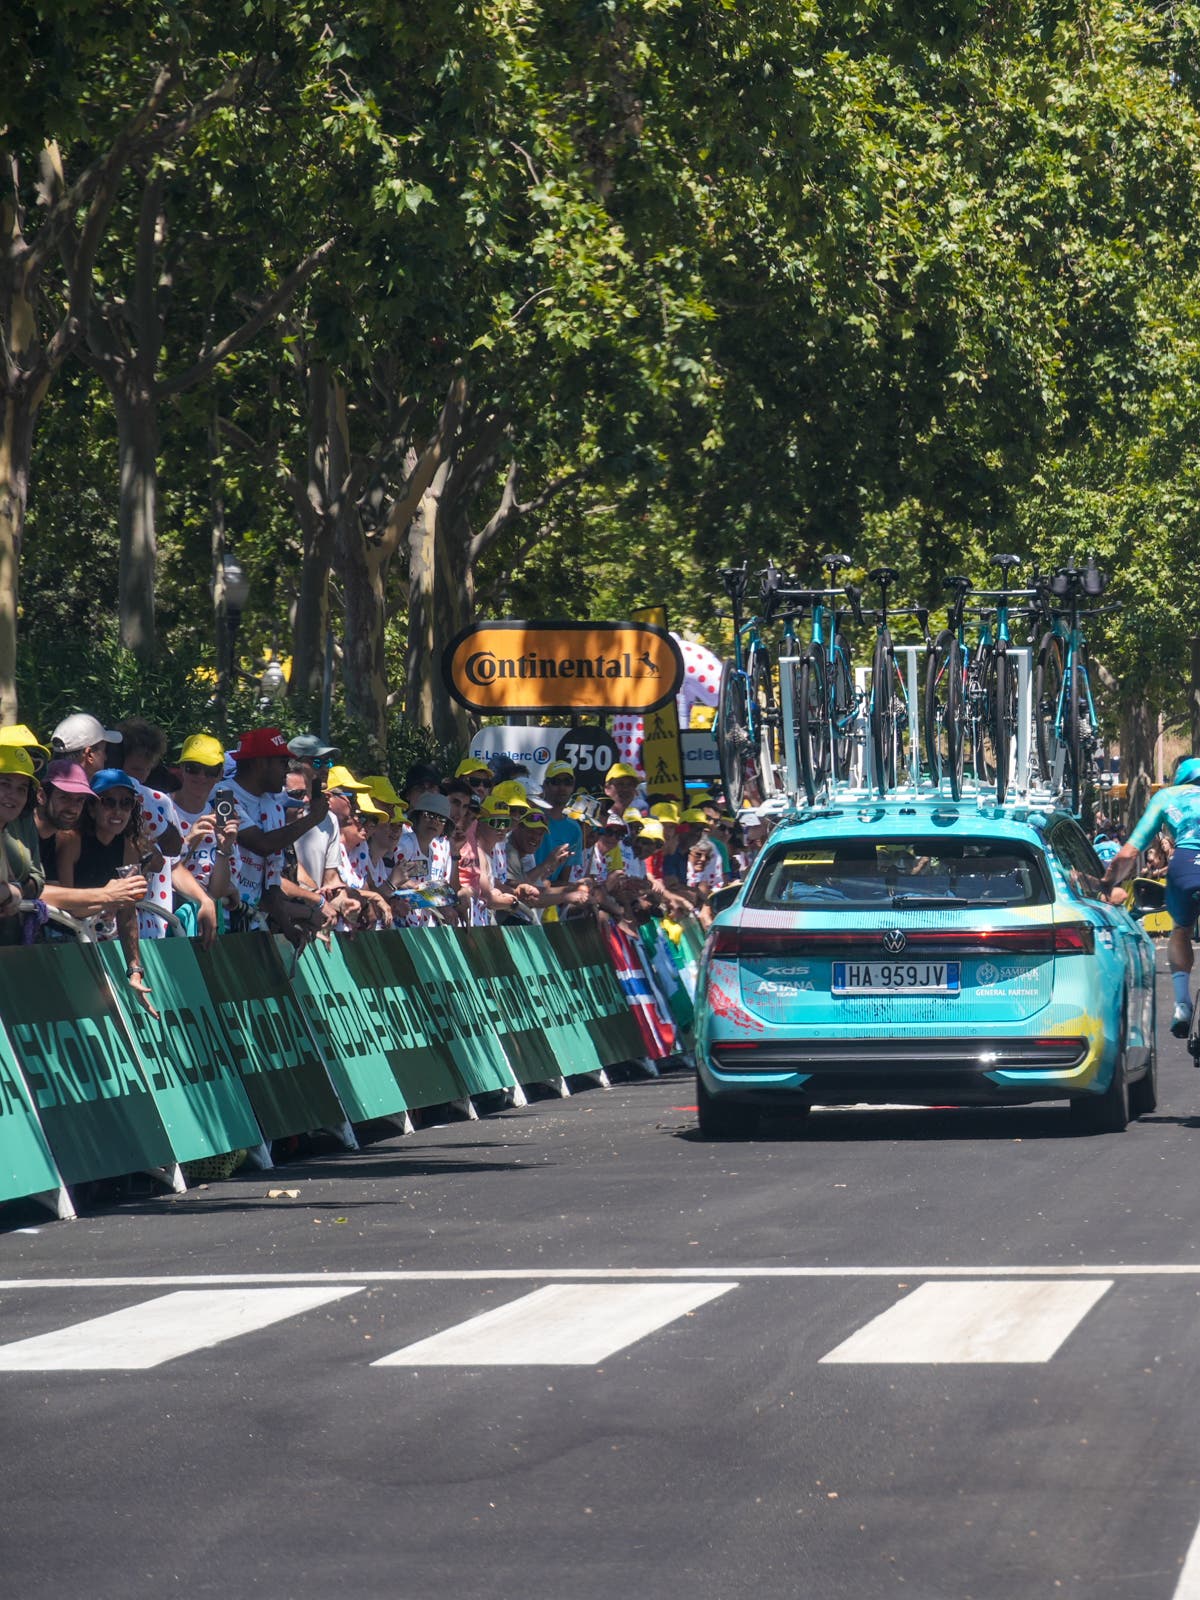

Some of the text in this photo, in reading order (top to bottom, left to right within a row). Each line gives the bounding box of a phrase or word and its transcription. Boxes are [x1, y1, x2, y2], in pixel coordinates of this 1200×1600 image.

[465, 651, 632, 686] Continental
[564, 744, 612, 771] 350
[849, 966, 873, 986] HA
[881, 965, 944, 986] 959JV
[757, 981, 815, 992] ASTANA
[975, 988, 1039, 996] GENERAL PARTNER
